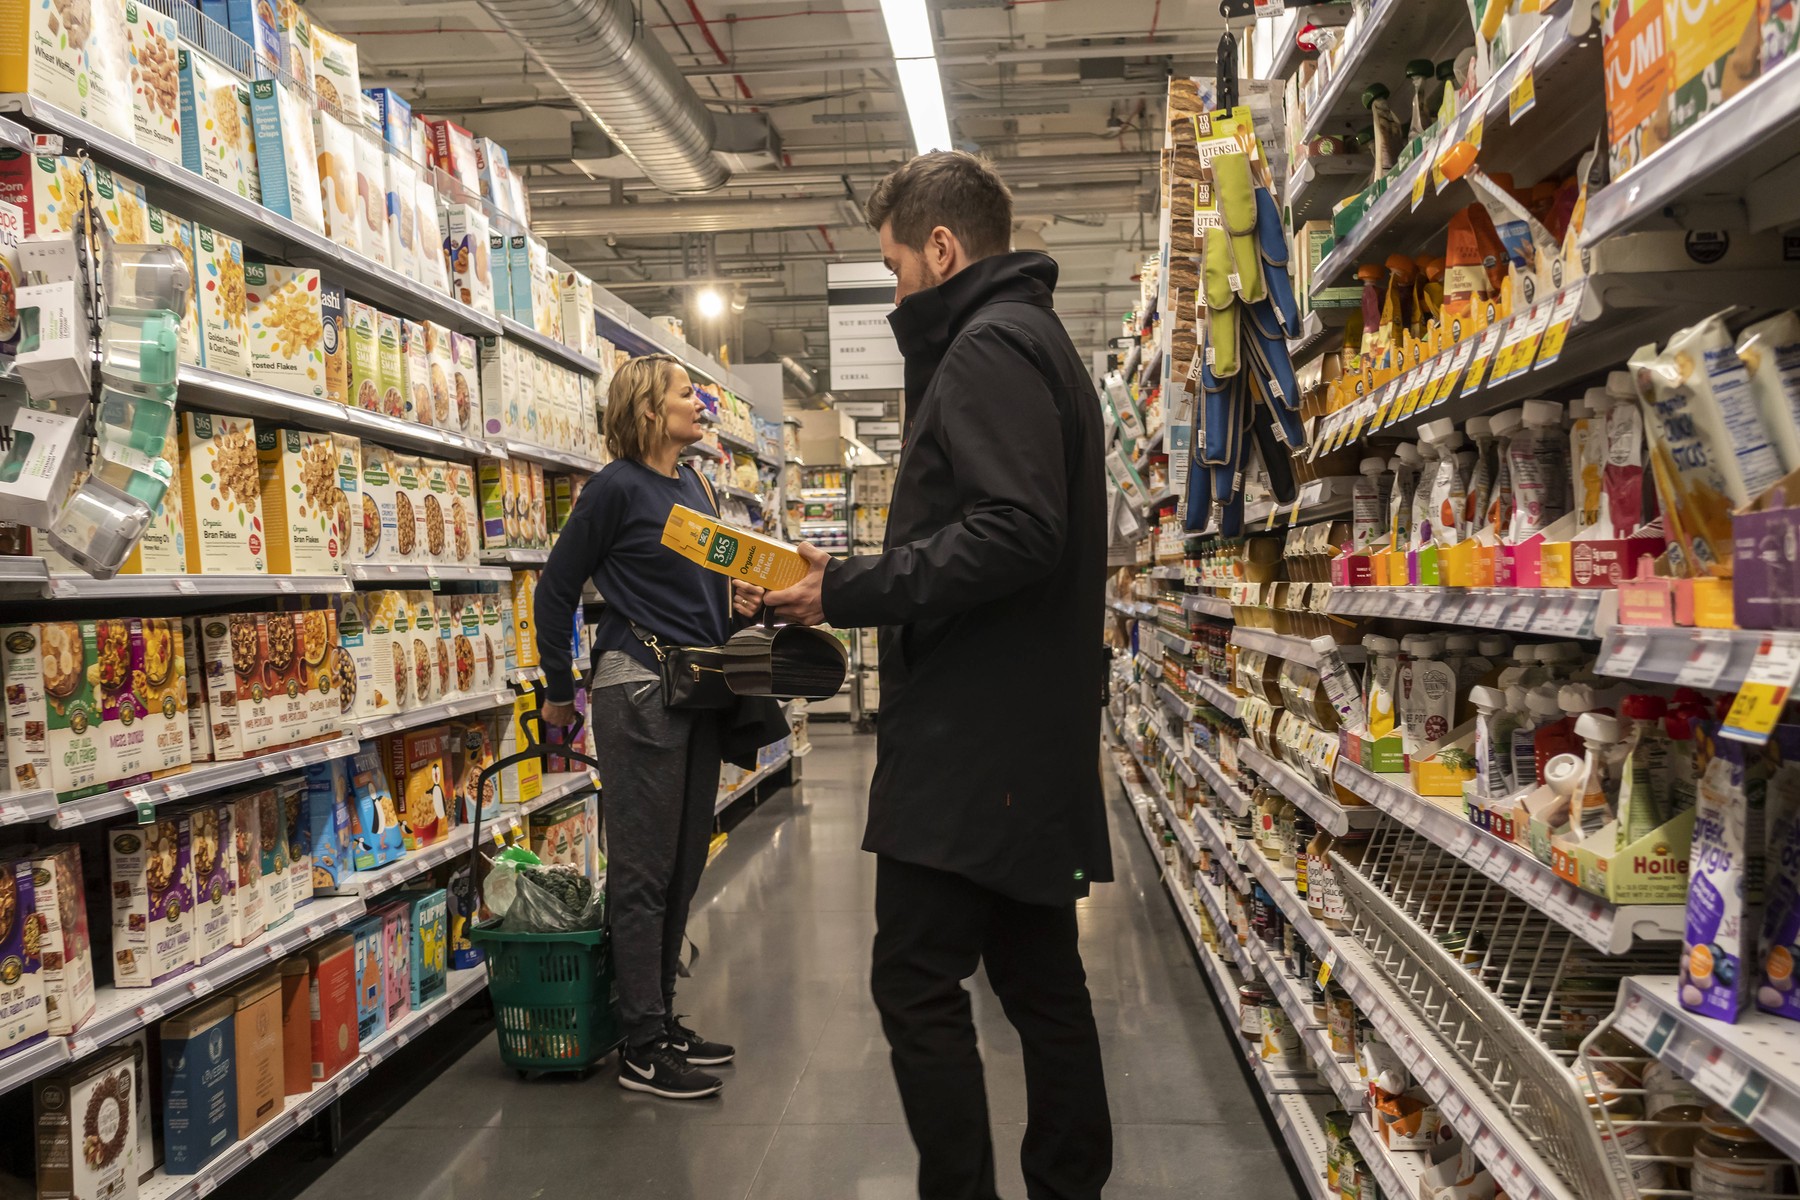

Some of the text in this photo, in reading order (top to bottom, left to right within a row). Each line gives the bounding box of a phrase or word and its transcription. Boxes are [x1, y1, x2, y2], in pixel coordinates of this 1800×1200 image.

[34, 44, 76, 76] Wheat Waffles
[1605, 15, 1665, 101] YUMI
[255, 83, 272, 94] 365
[1198, 114, 1209, 123] TO
[1200, 122, 1210, 130] GO
[435, 125, 448, 157] PUFFINS
[1201, 143, 1240, 158] UTENSIL
[0, 193, 28, 203] lakes
[1197, 217, 1223, 228] UTEN
[200, 229, 213, 244] 365
[246, 266, 264, 277] 365
[321, 286, 341, 310] ashi
[838, 319, 855, 327] NUT
[839, 346, 866, 354] BREAD
[250, 361, 298, 371] rosted Flakes
[839, 373, 870, 381] CEREAL
[196, 416, 211, 431] 365
[257, 433, 275, 444] 365
[287, 434, 300, 445] 365
[202, 518, 222, 530] Organic
[292, 524, 308, 534] Organic
[204, 530, 238, 540] Bran Flakes
[293, 535, 319, 544] Bran Flakes
[713, 537, 730, 563] 365
[740, 545, 757, 575] Organic
[753, 553, 766, 573] Bran
[760, 551, 776, 580] Flakes
[520, 630, 533, 664] THREE
[1633, 855, 1689, 875] Holle
